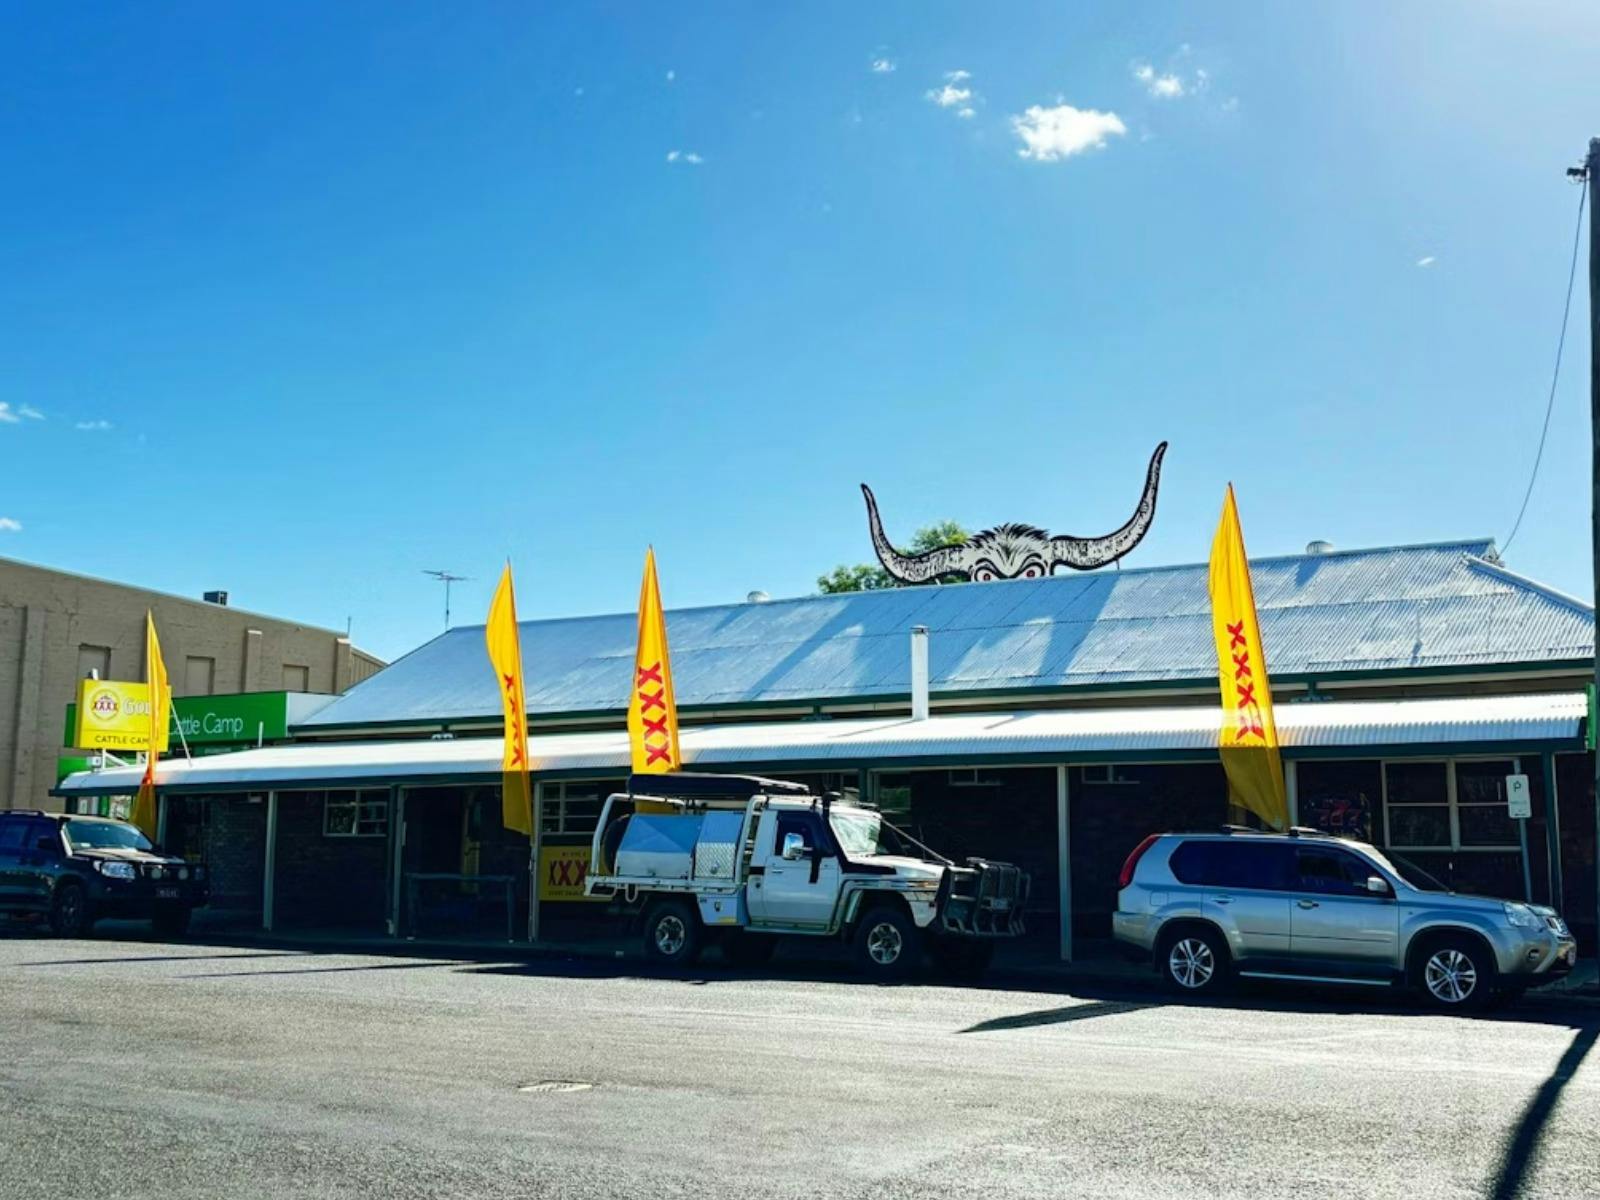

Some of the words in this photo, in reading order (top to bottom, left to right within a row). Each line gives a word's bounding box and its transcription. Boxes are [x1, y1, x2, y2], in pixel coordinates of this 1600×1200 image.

[202, 712, 244, 739] Camp
[637, 661, 672, 767] XXXX
[94, 735, 127, 745] CATTLE
[130, 737, 150, 745] CAM
[548, 859, 590, 887] XXX
